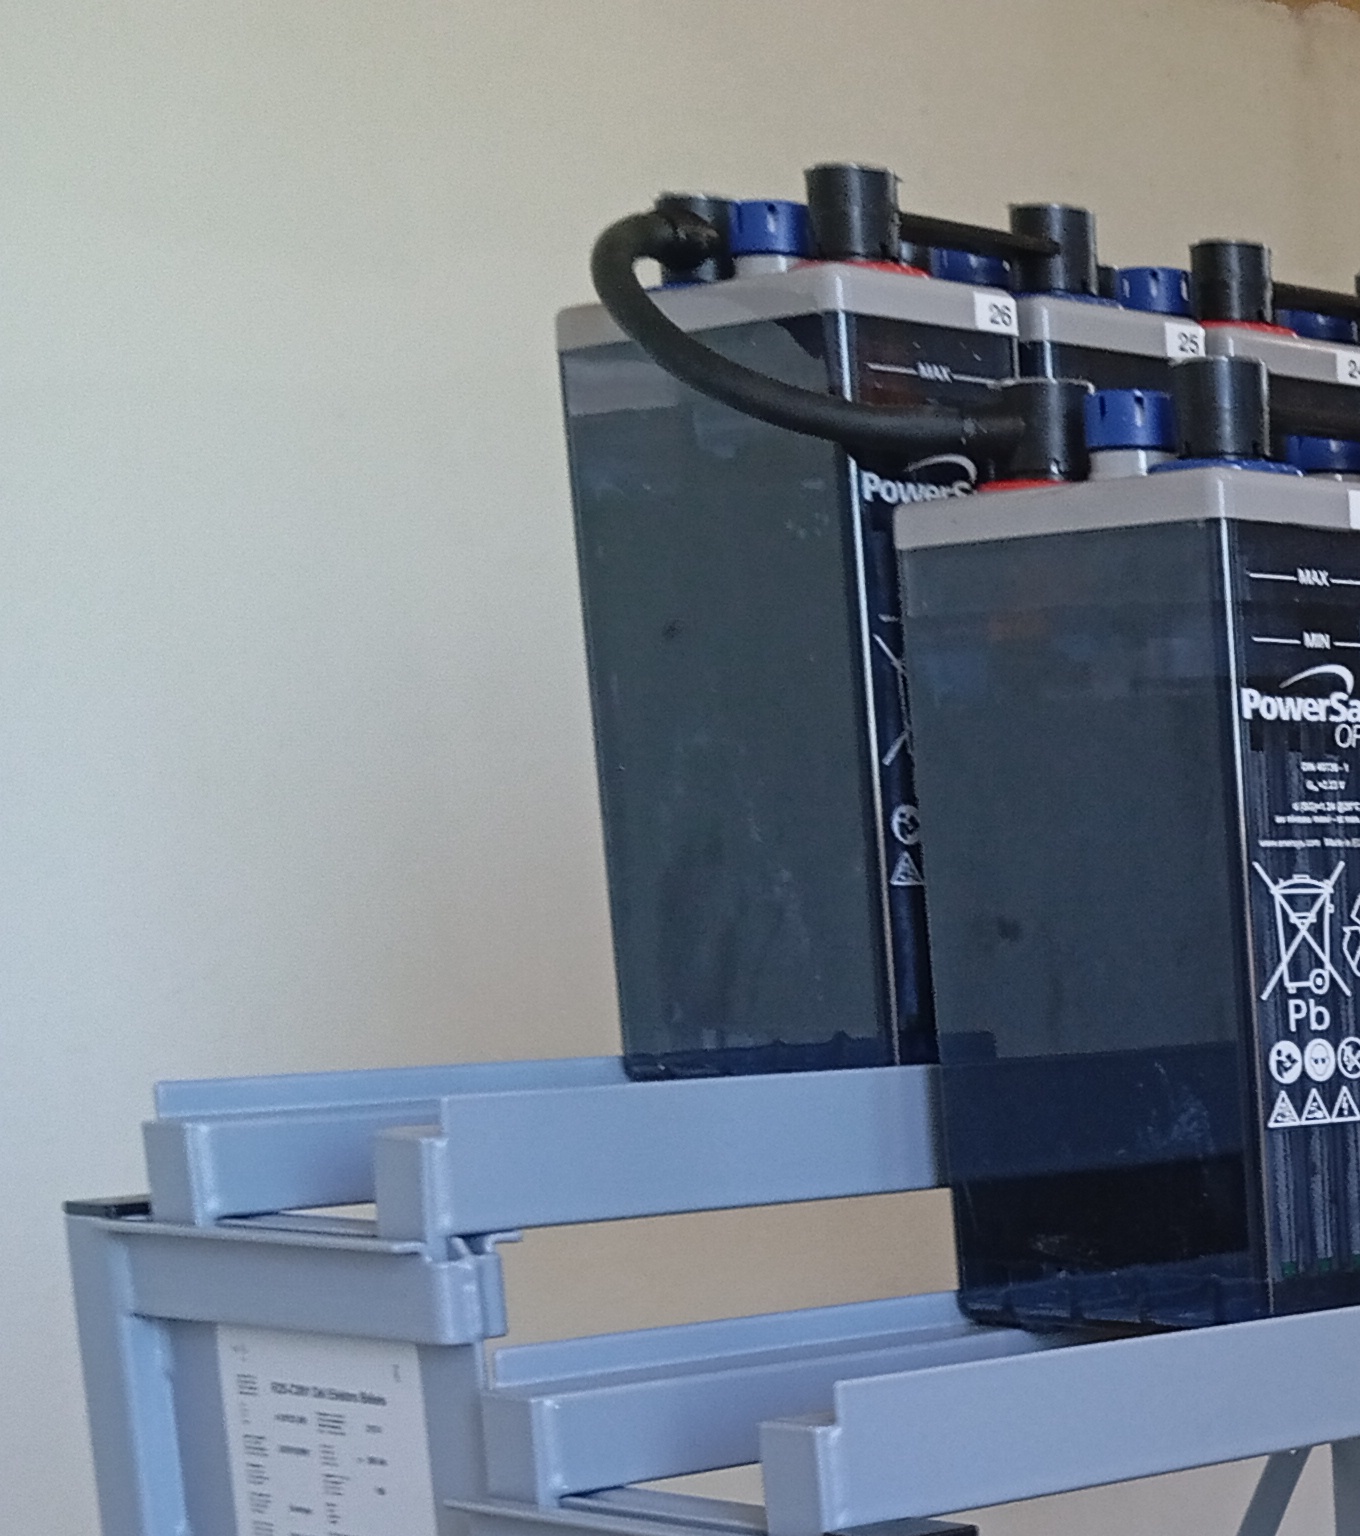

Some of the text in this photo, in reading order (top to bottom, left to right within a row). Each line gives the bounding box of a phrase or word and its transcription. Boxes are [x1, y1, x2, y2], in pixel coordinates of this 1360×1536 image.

[989, 302, 1012, 327] 26
[1178, 332, 1200, 355] 25
[1296, 567, 1331, 588] MAX
[1302, 630, 1332, 650] MIN
[1288, 998, 1332, 1033] Pb
